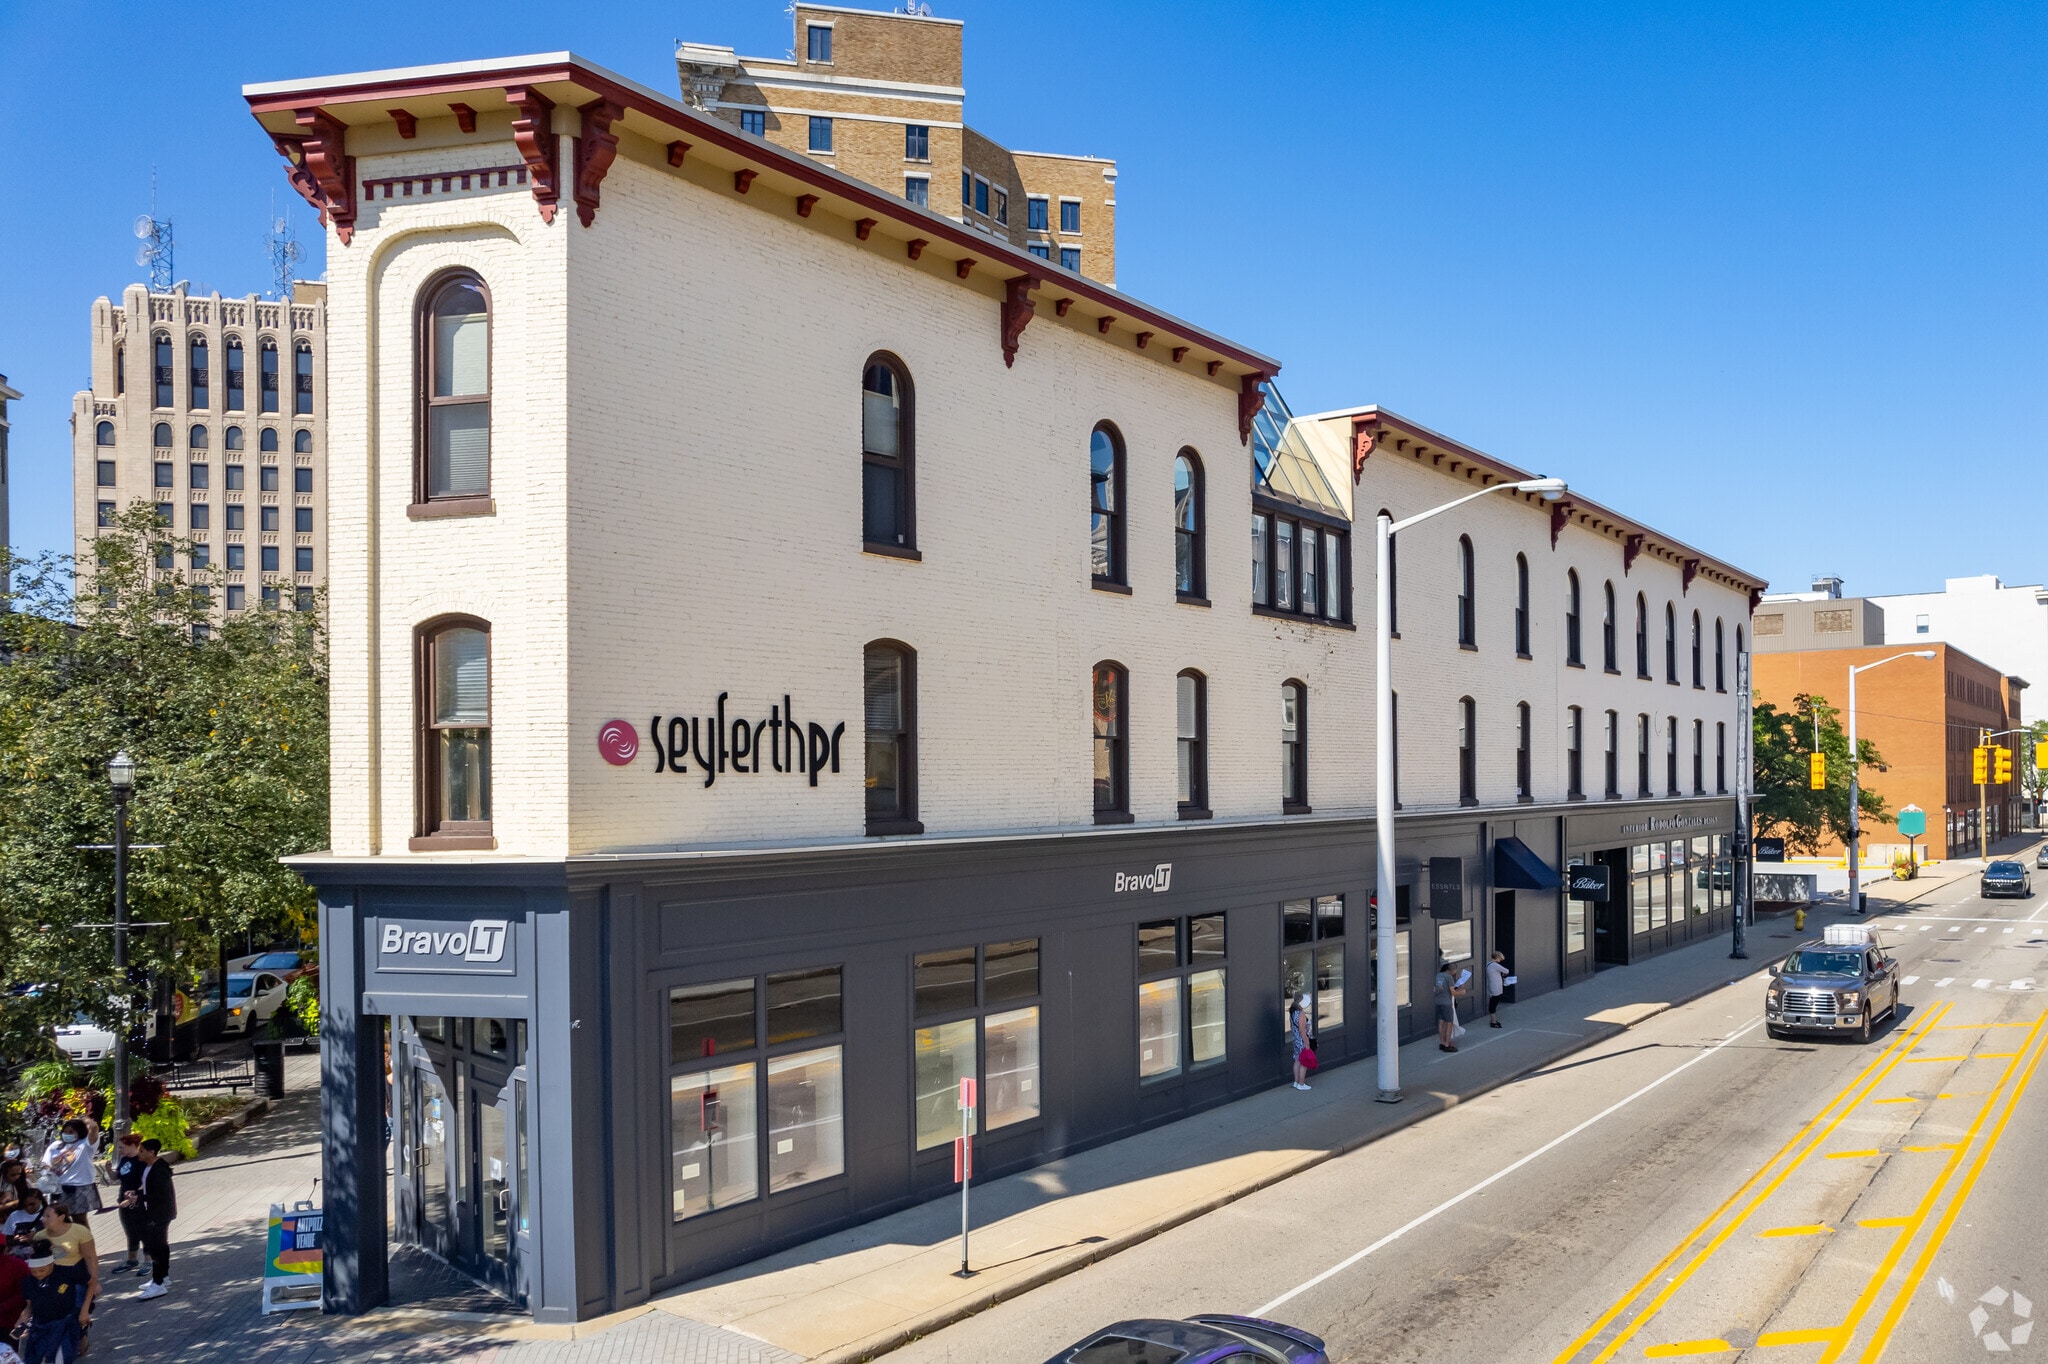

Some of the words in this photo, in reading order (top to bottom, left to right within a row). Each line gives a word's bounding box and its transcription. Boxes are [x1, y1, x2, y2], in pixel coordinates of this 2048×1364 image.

[651, 691, 846, 789] seyferthpr
[1622, 822, 1648, 834] INTERIOR
[1649, 816, 1675, 831] RODOLFO
[1757, 846, 1782, 855] Baker
[1572, 876, 1605, 890] Baker
[296, 1216, 323, 1232] ARTPRIZ
[296, 1233, 315, 1248] VENUE
